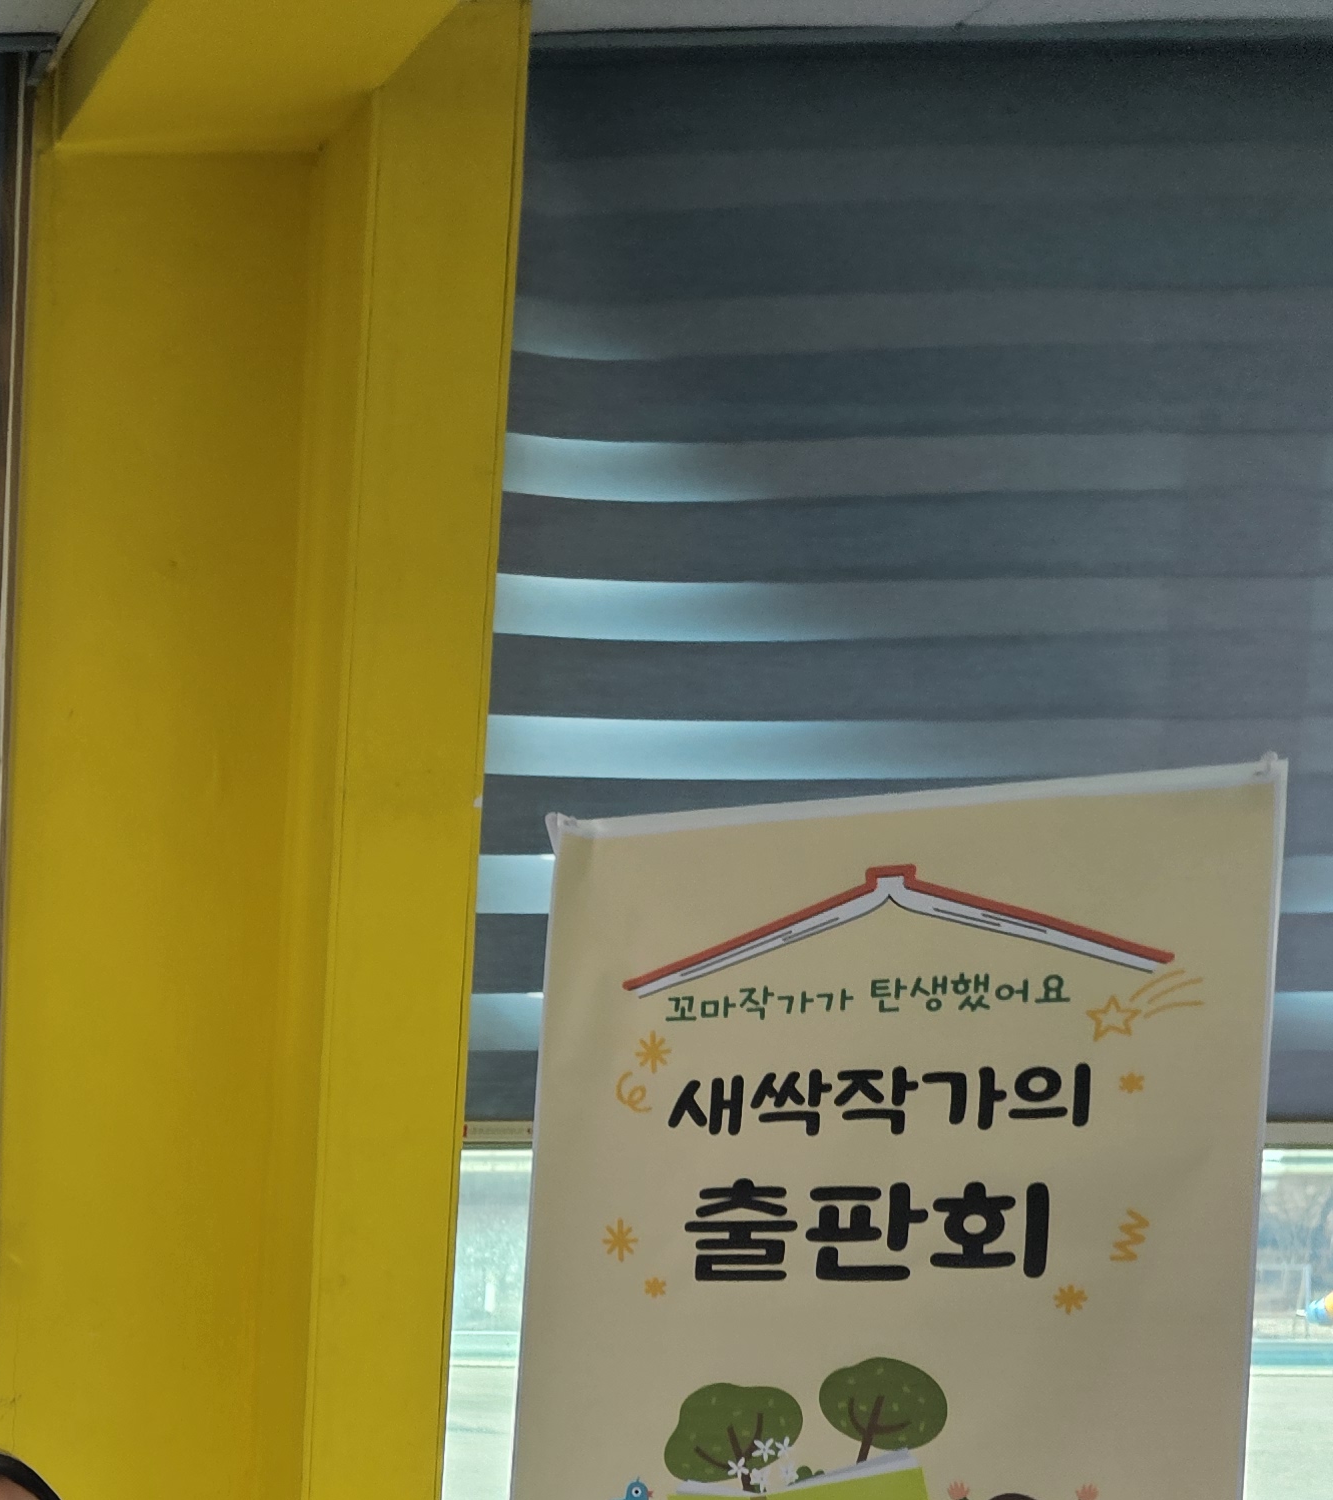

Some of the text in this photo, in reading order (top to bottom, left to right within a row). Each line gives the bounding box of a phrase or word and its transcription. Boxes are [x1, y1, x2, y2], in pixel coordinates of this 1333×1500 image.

[665, 972, 1072, 1023] 꼬마작가가 탄생했어요
[668, 1062, 1092, 1136] 새싹작가의
[685, 1178, 1051, 1282] 출판회
